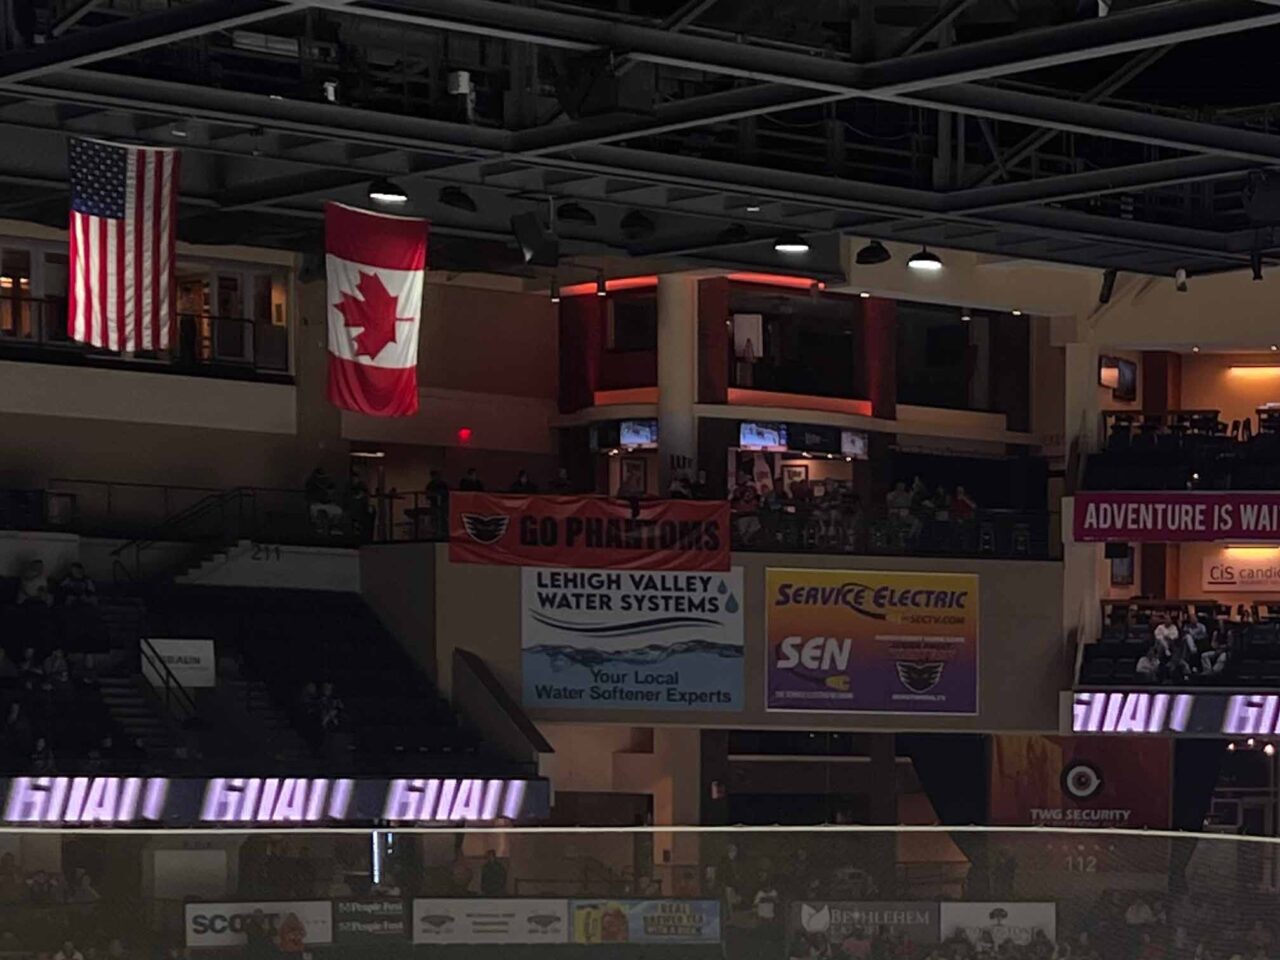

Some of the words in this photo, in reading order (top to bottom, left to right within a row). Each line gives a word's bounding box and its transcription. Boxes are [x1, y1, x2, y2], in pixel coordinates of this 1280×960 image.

[1084, 503, 1206, 531] ADVENTURE
[1214, 504, 1233, 531] IS
[520, 515, 558, 547] GO
[566, 516, 721, 552] PHANTOMS
[536, 571, 622, 591] LEHIGH
[629, 573, 712, 593] VALLEY
[536, 591, 613, 611] WATER
[620, 594, 720, 614] SYSTEMS
[775, 582, 866, 608] SERVICE
[872, 586, 969, 609] ELECTRIC
[776, 635, 853, 671] SEN
[589, 668, 627, 688] Your
[633, 669, 679, 687] Local
[535, 685, 586, 701] Water
[589, 683, 661, 704] Softener
[666, 687, 732, 708] Experts
[1030, 808, 1063, 821] TWG
[1066, 808, 1132, 821] SECURITY
[1065, 856, 1097, 873] 112
[830, 908, 930, 926] BETHLEHEM
